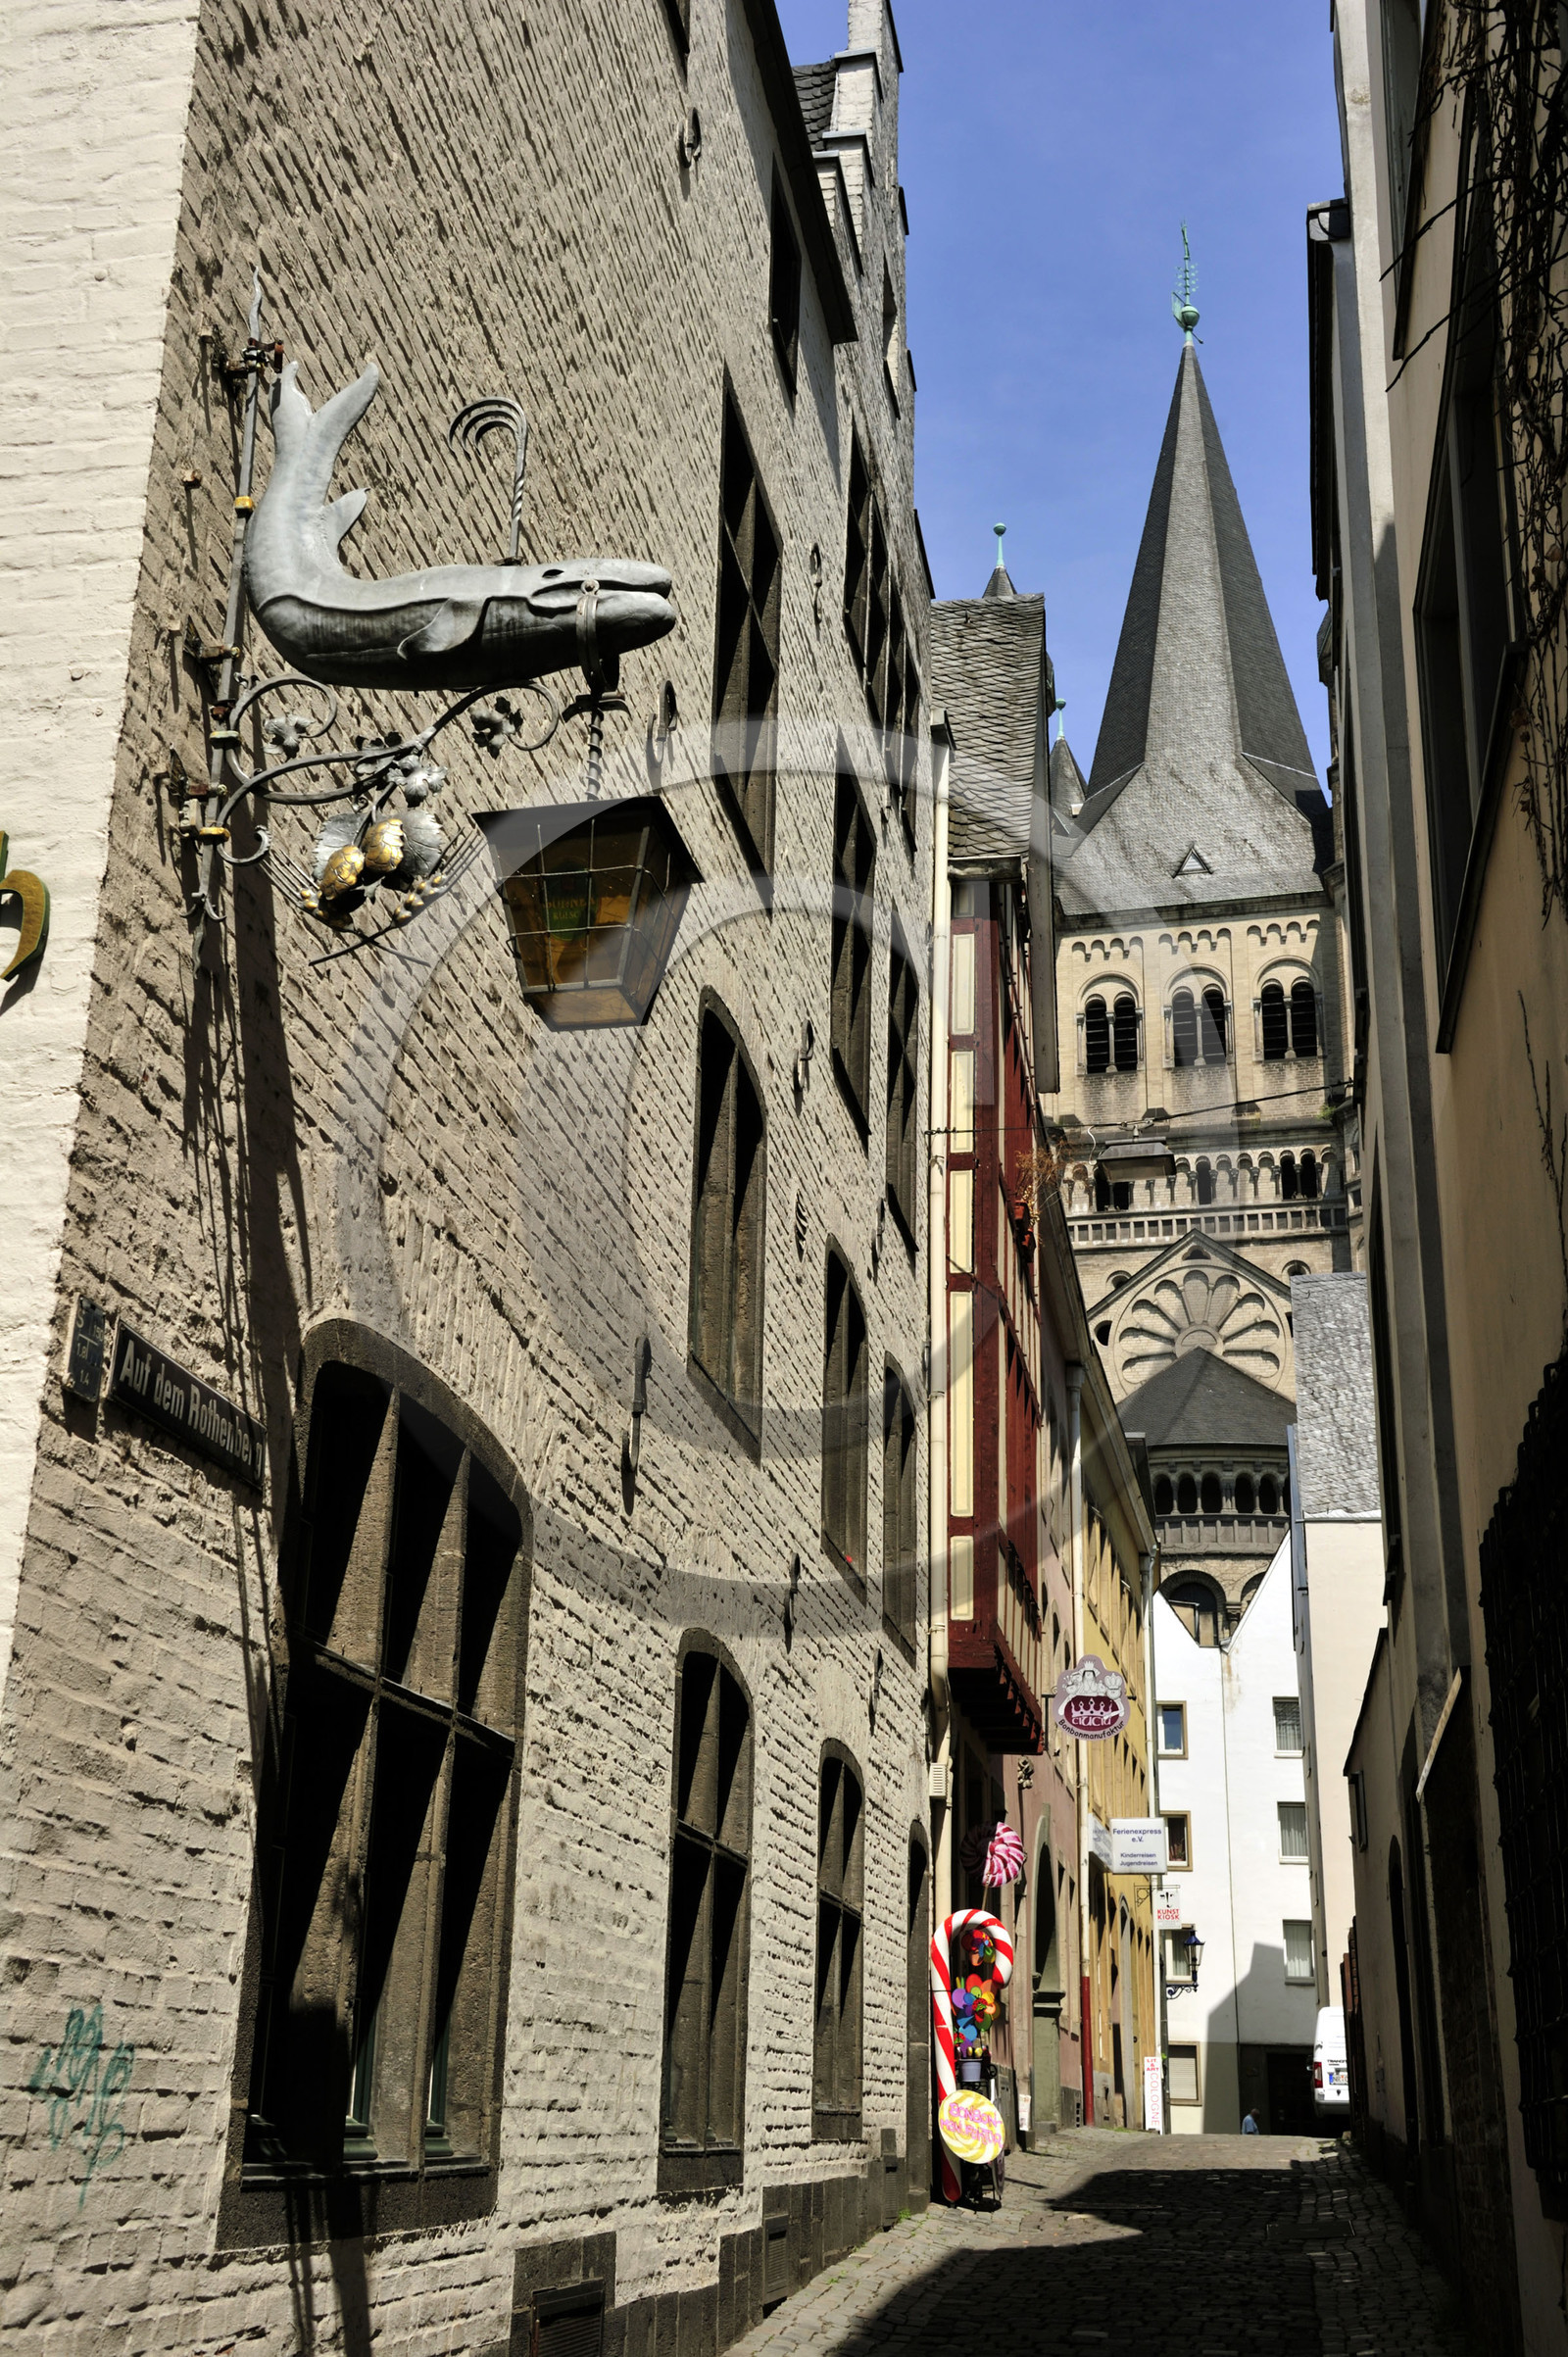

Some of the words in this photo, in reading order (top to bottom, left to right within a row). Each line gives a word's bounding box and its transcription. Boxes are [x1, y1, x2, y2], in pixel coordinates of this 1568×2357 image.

[120, 1339, 151, 1396] Auf
[154, 1363, 184, 1419] dem
[1058, 1719, 1124, 1740] Bonbonmanufaktur
[1151, 2073, 1159, 2126] COLOGNE
